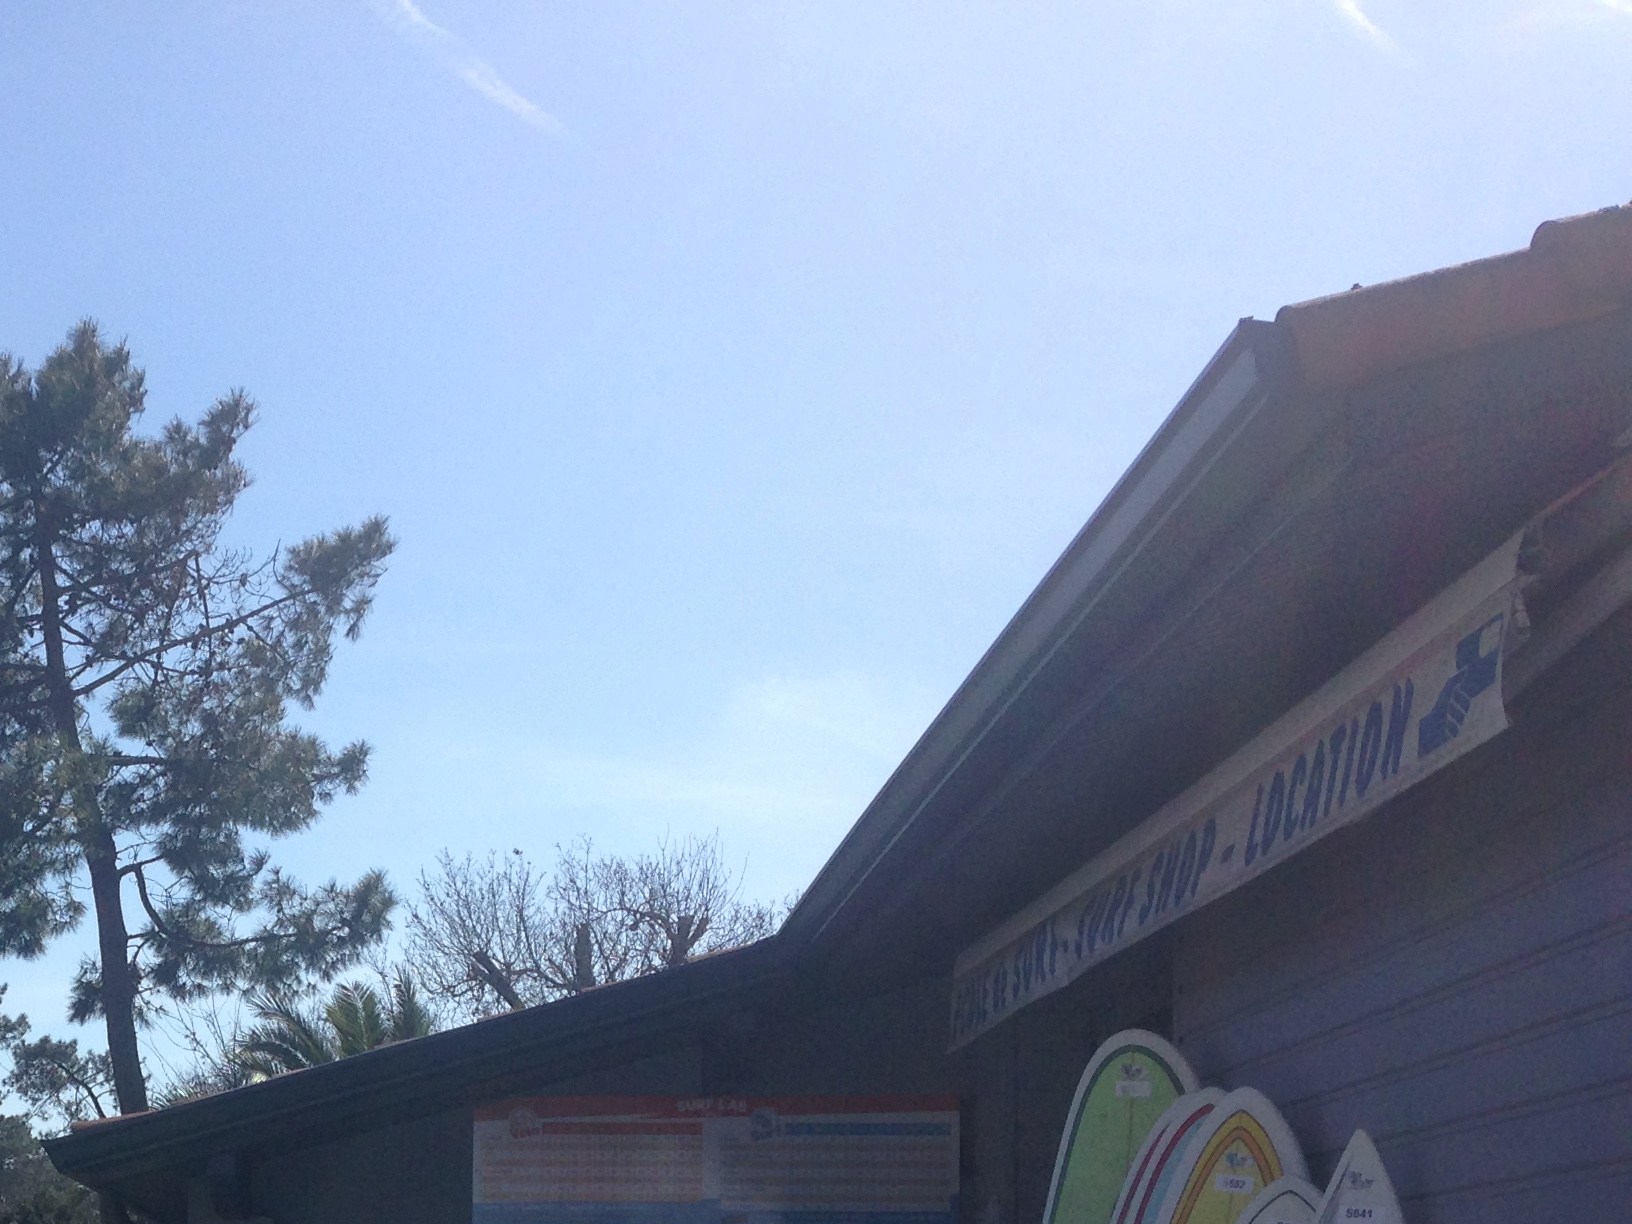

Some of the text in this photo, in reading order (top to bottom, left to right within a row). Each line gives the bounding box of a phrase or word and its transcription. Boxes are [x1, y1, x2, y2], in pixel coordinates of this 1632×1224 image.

[1074, 866, 1142, 959] SURF
[1138, 818, 1216, 925] SHOP
[1245, 676, 1414, 867] LOCATION
